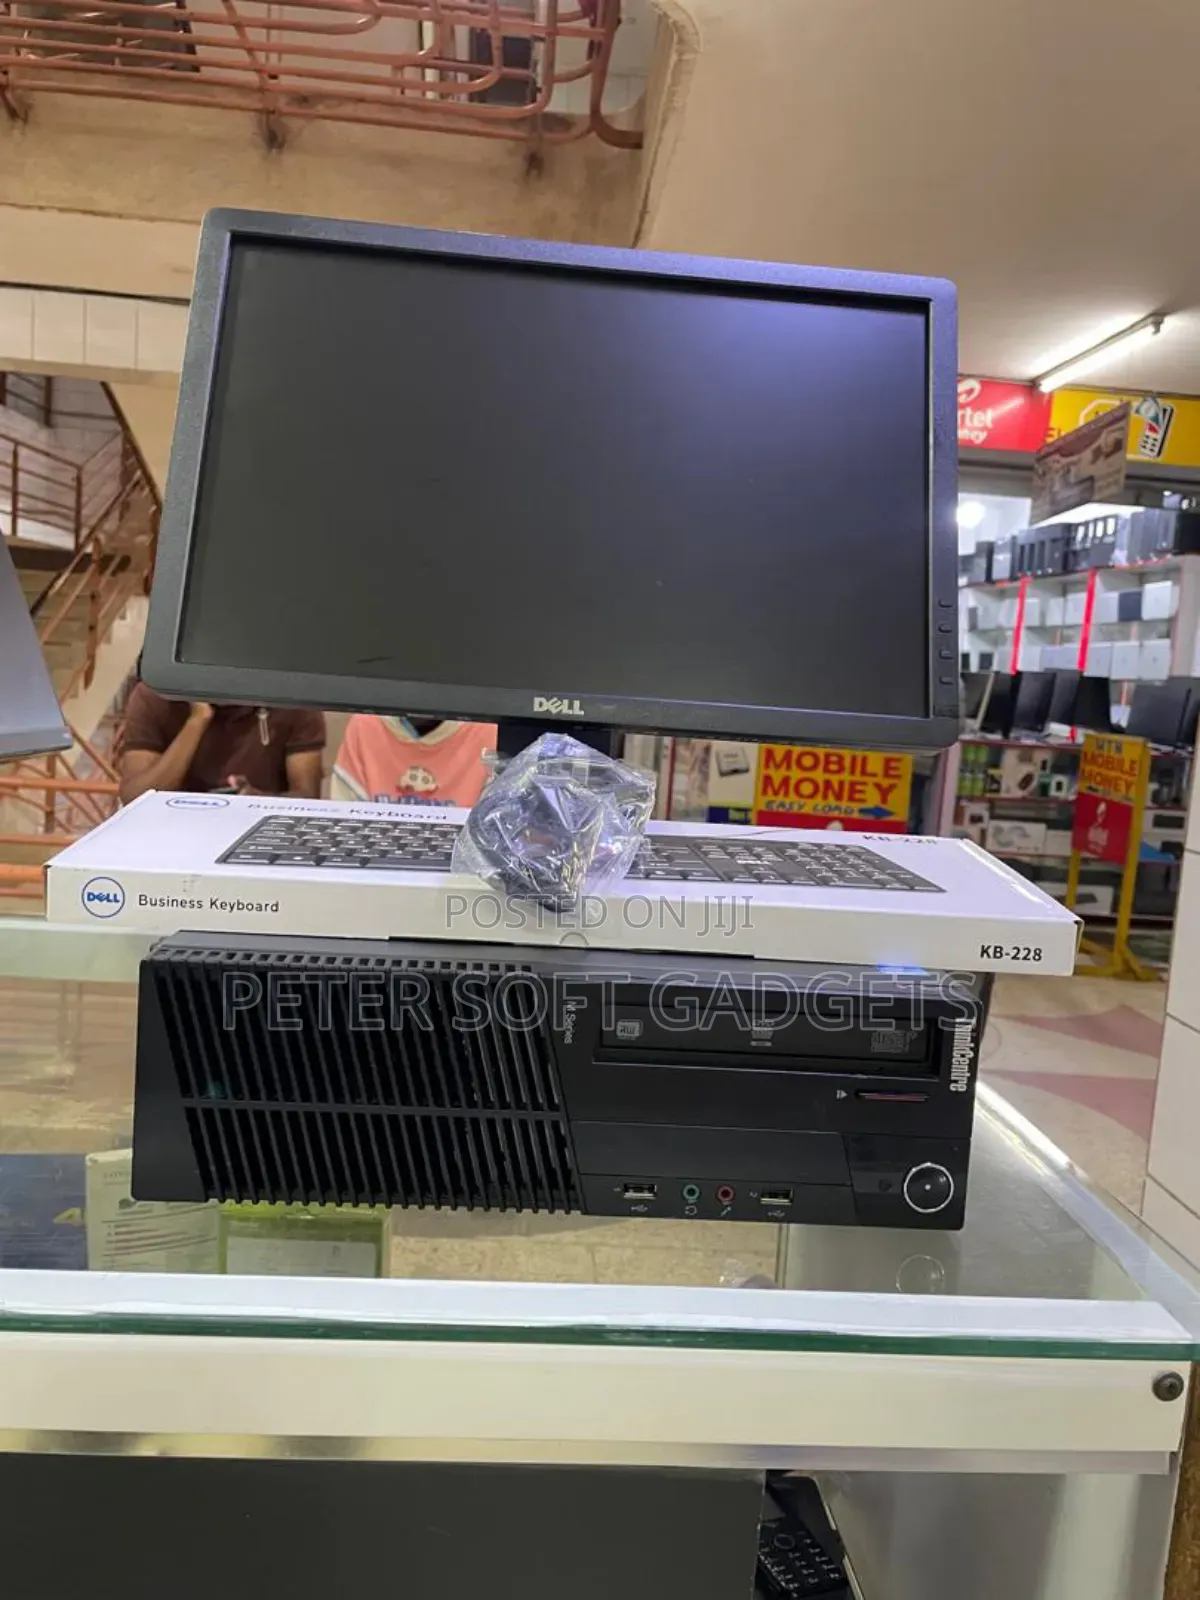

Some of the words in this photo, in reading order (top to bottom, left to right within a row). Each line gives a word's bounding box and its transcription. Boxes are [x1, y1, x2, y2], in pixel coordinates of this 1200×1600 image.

[533, 697, 585, 716] DELL
[764, 747, 903, 779] MOBILE
[1082, 748, 1138, 777] MOBILE
[761, 775, 898, 806] MONEY
[1080, 767, 1136, 795] MONEY
[349, 808, 447, 821] Keyboard
[86, 891, 120, 904] DELL
[138, 894, 203, 909] Business
[209, 899, 280, 913] Keyboard
[980, 944, 1043, 962] KB-228
[950, 1017, 977, 1093] ThinkCentre
